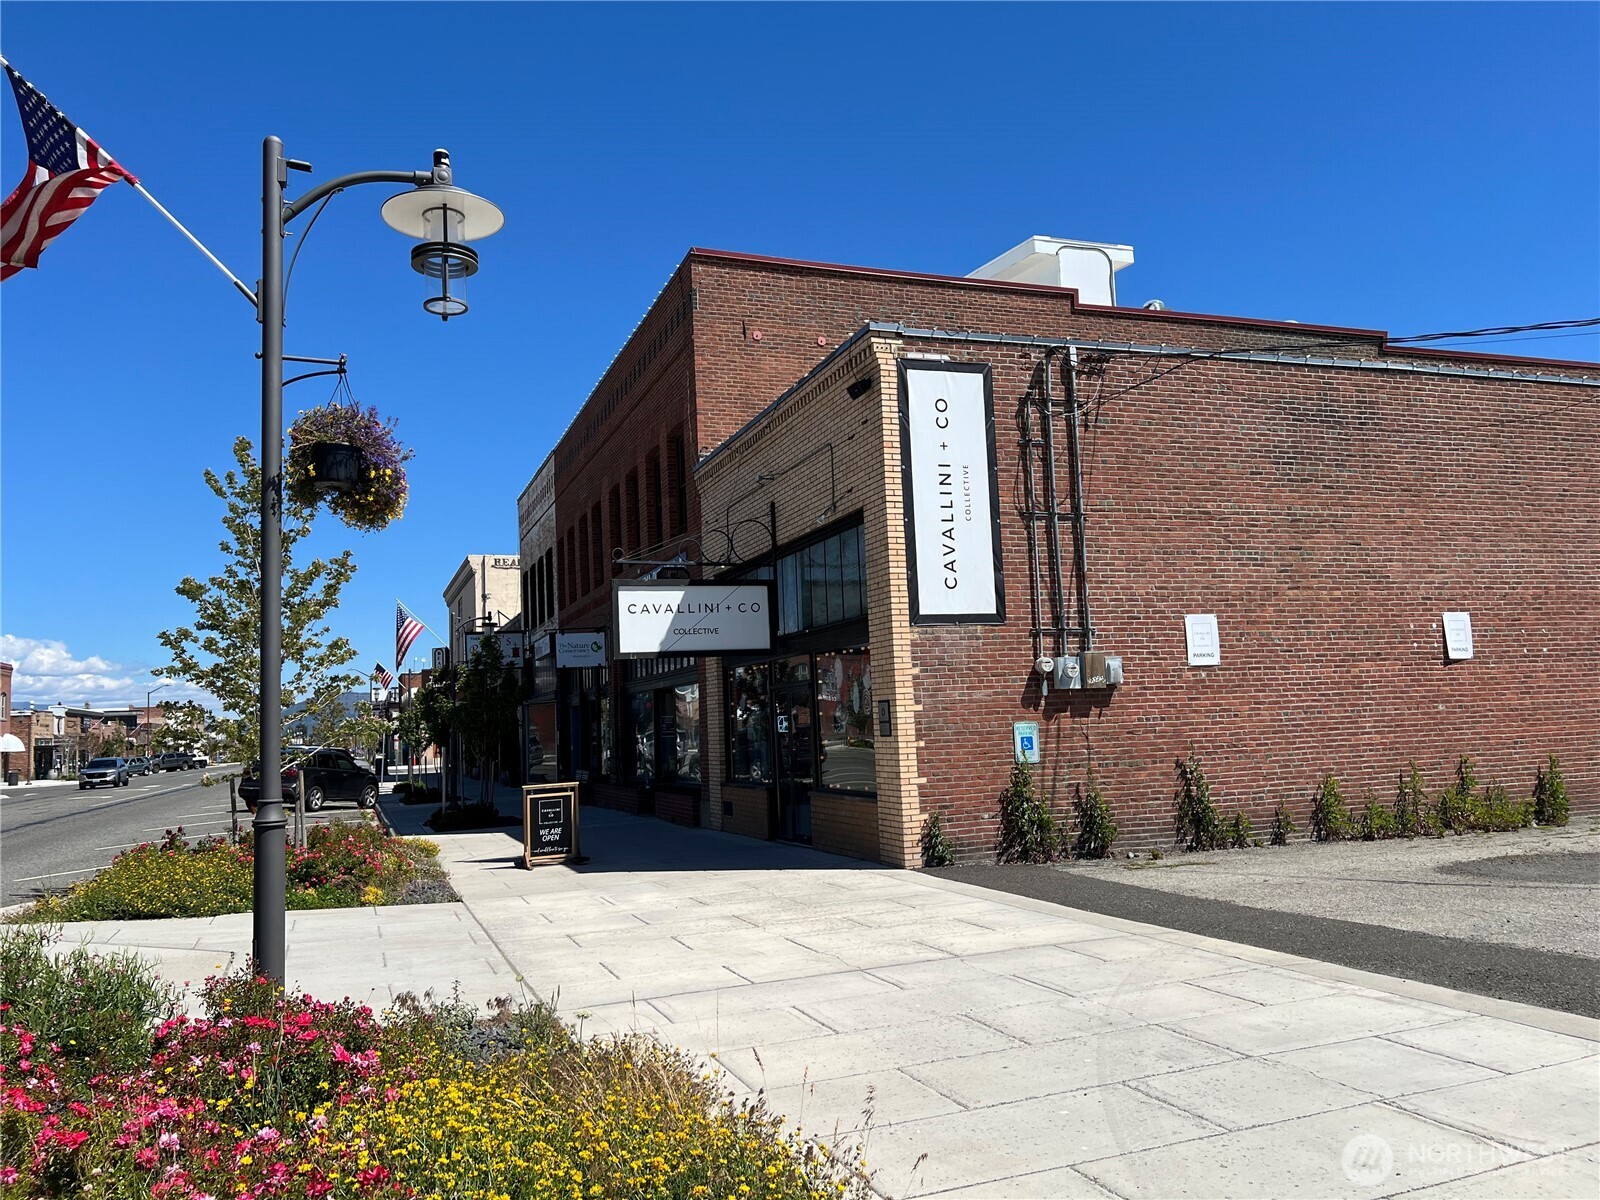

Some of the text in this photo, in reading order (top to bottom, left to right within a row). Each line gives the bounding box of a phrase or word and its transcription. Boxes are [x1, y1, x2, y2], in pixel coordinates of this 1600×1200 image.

[935, 398, 958, 590] CAVALLINI + CO
[963, 464, 972, 522] COLLECTIVE
[627, 603, 720, 615] CAVALLINI
[737, 602, 761, 613] CO
[673, 627, 720, 635] COLLECTIVE
